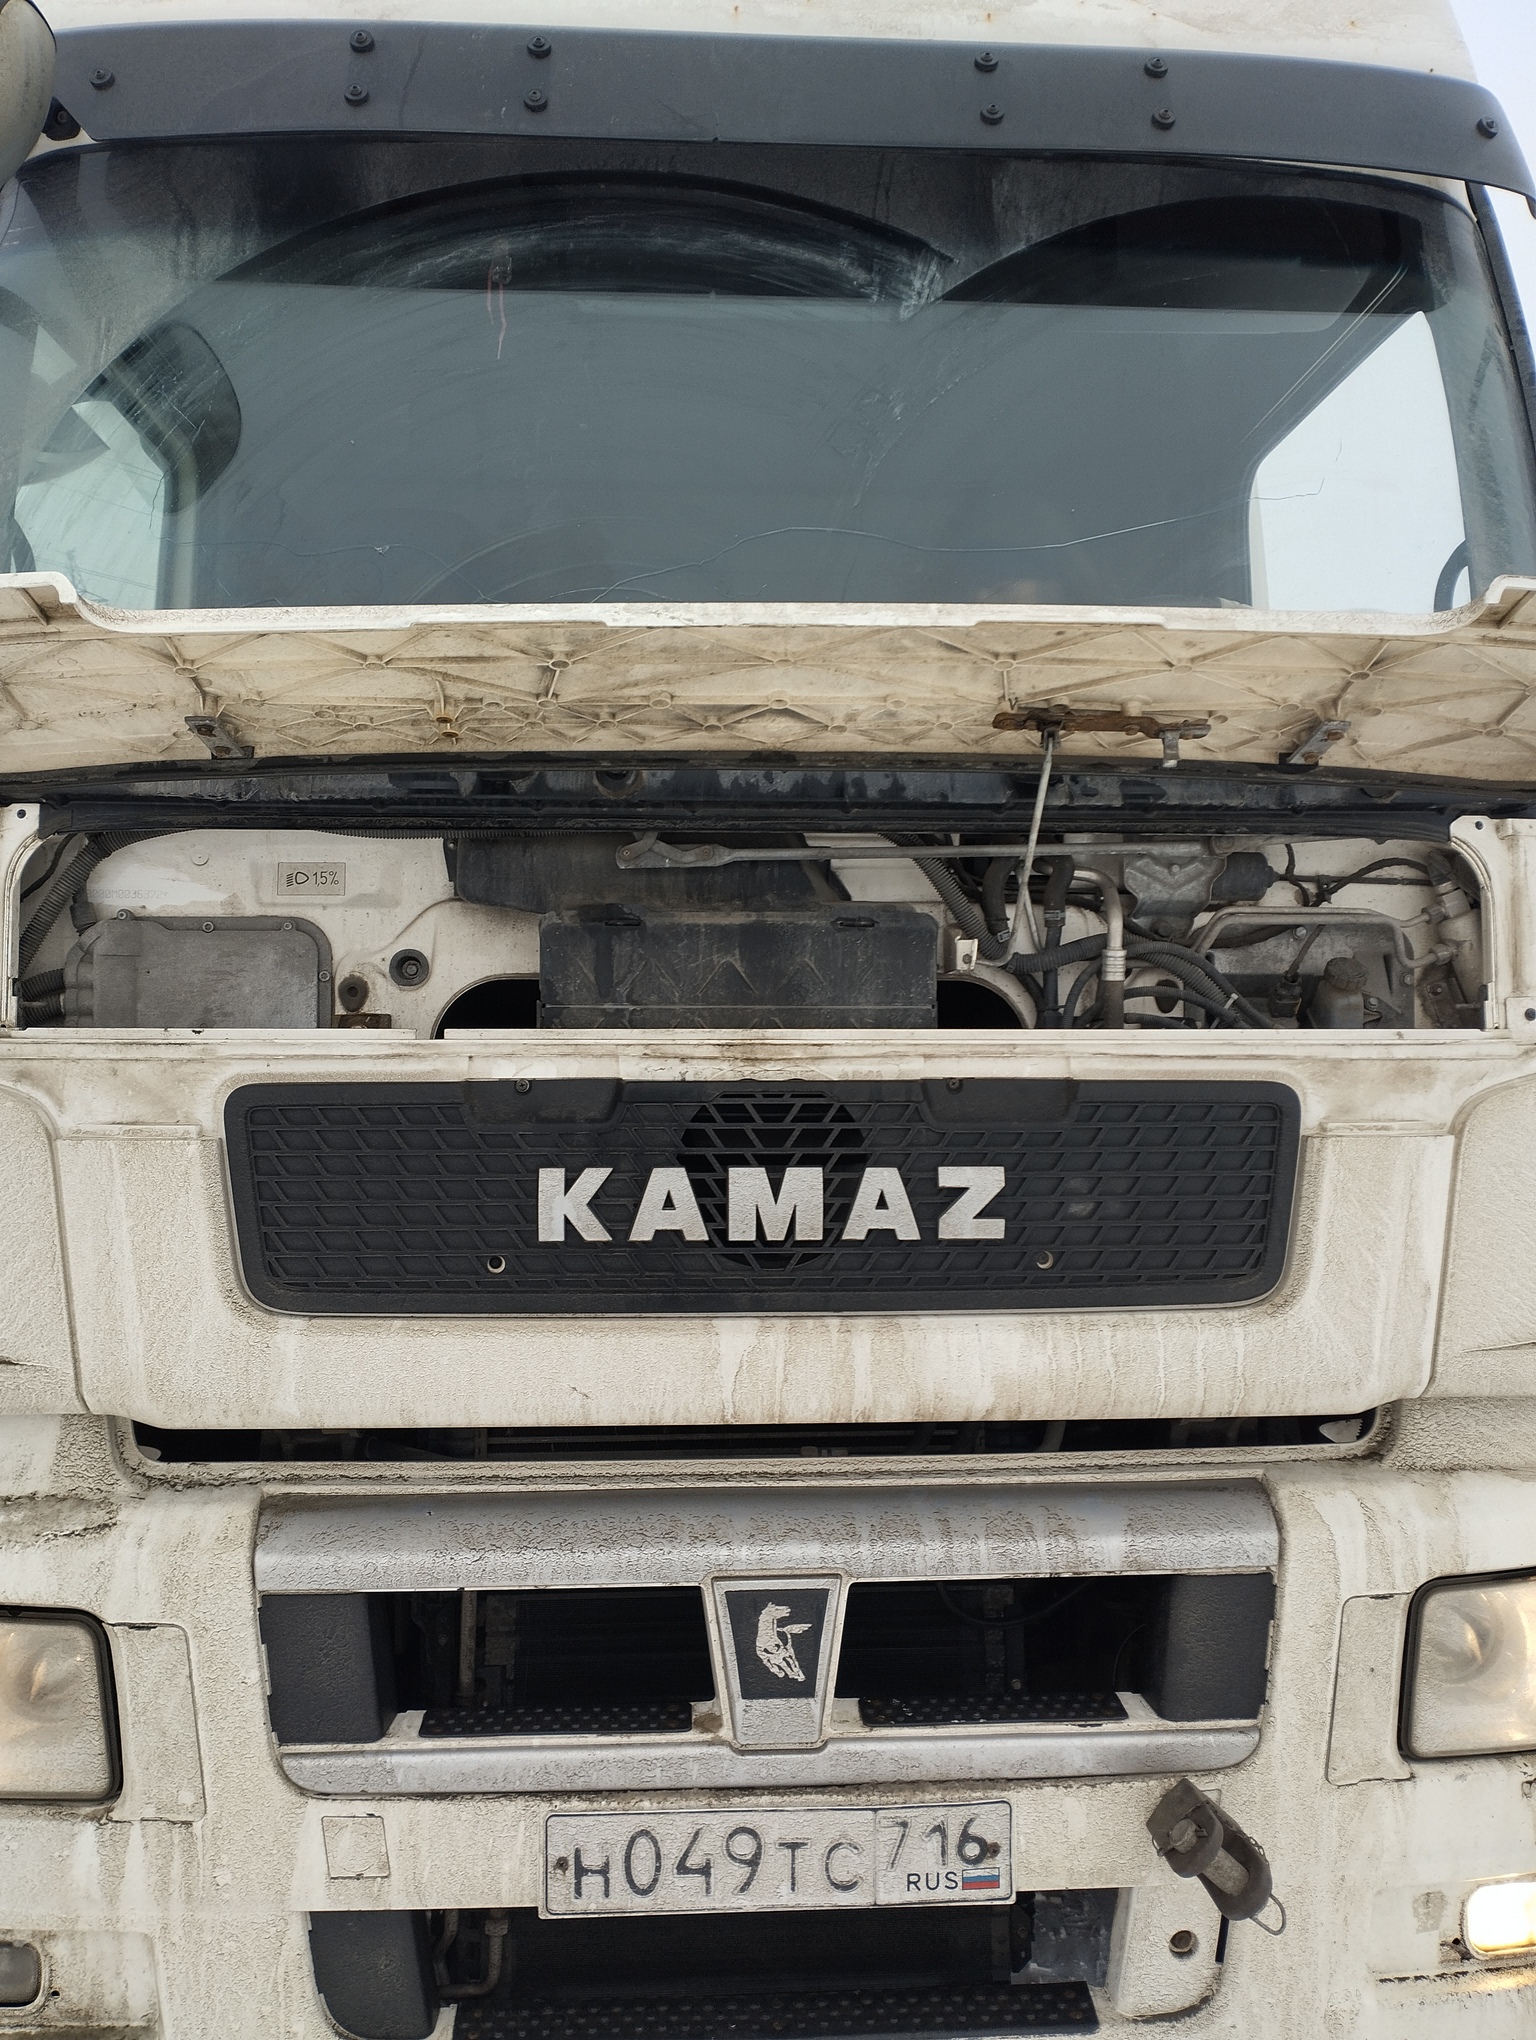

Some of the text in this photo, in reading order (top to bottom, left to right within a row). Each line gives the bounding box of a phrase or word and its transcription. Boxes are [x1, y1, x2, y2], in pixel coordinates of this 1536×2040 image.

[538, 1166, 1006, 1242] KAMAZ
[886, 1817, 990, 1871] 716
[906, 1873, 959, 1892] RUS
